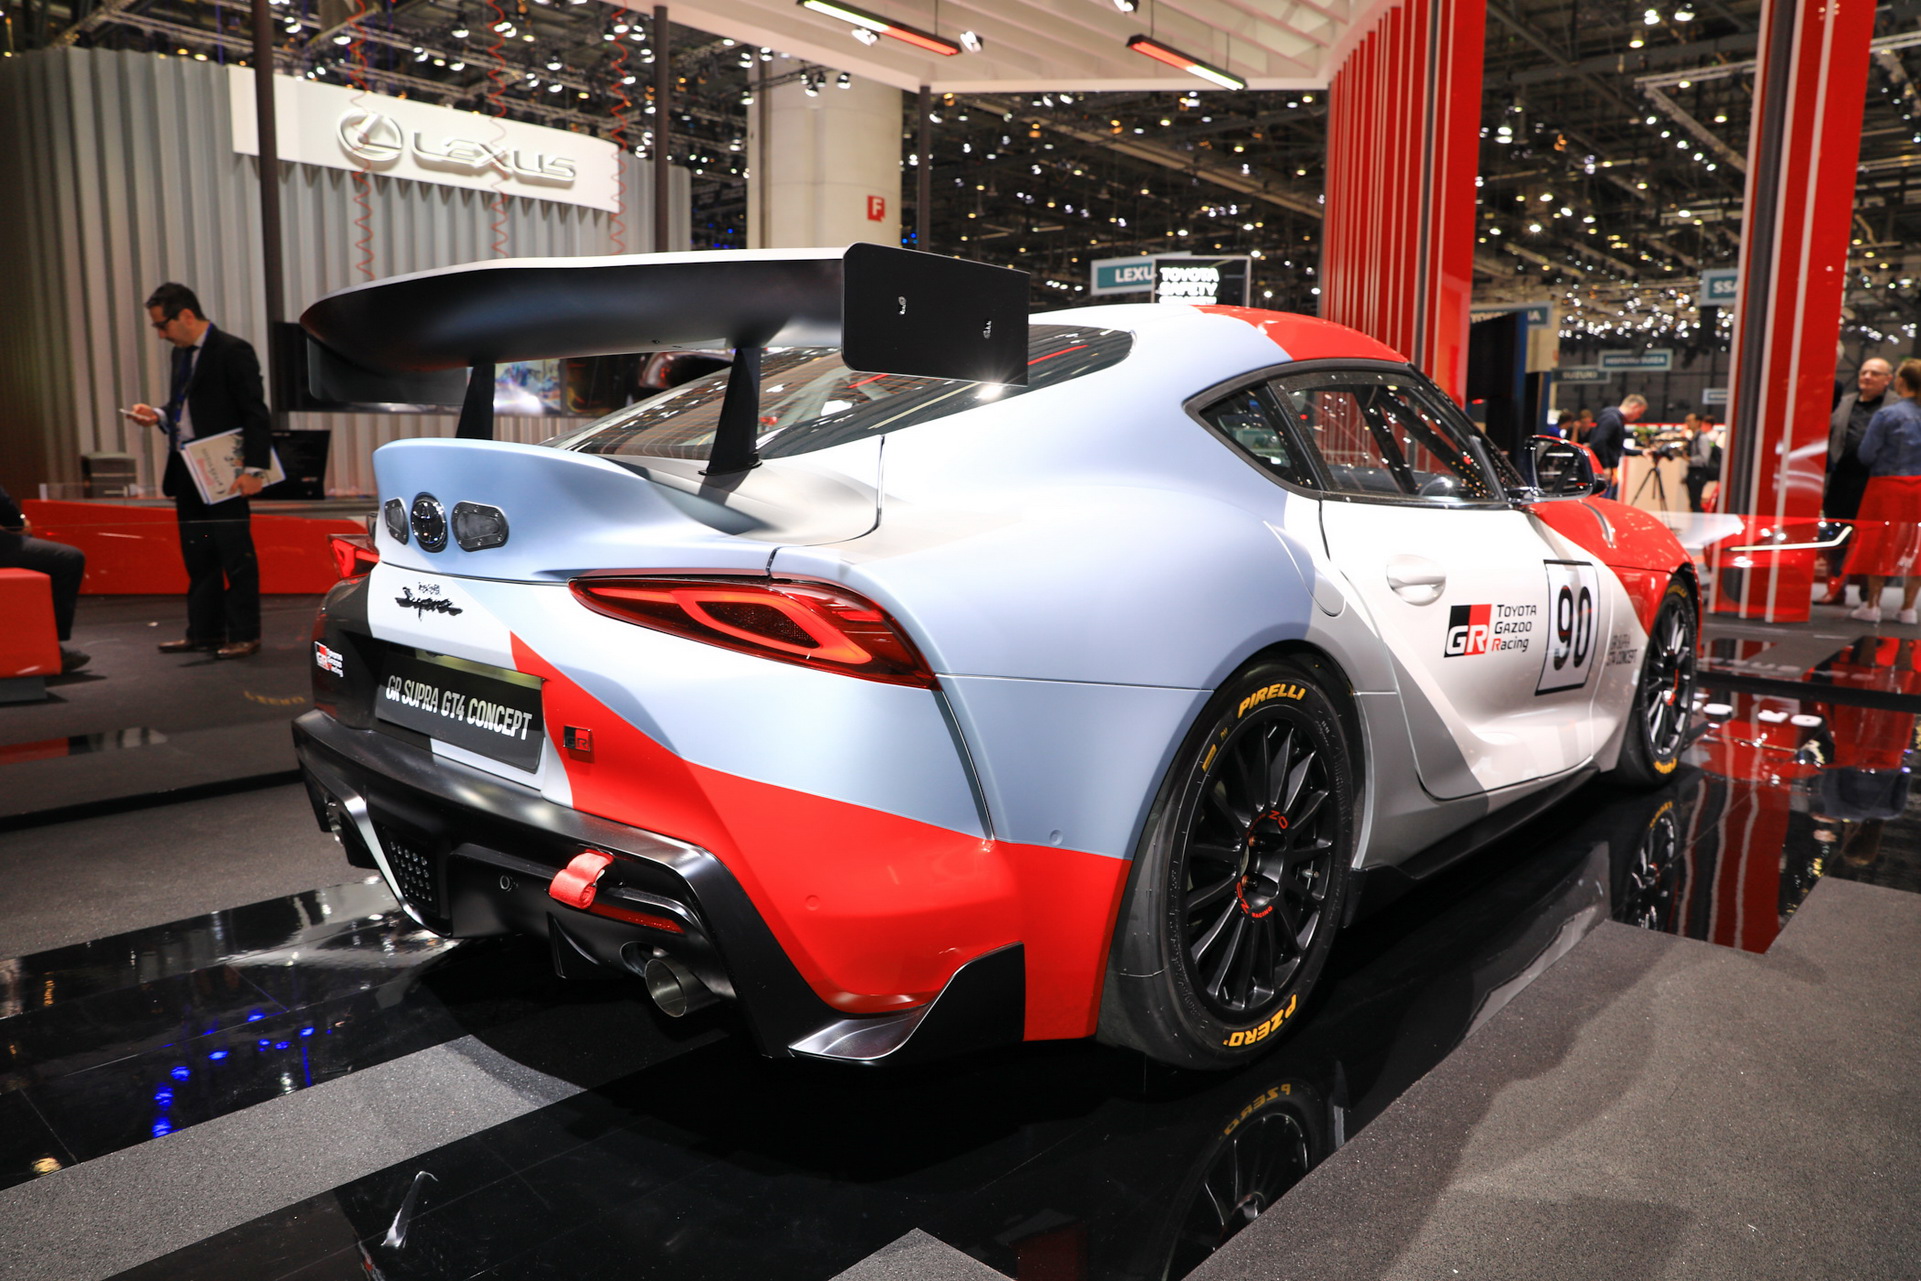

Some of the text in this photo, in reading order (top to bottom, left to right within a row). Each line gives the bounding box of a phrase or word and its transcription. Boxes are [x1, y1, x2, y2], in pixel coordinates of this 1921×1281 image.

[411, 131, 576, 184] LEXUS
[872, 198, 883, 216] F
[1160, 267, 1220, 282] TOYOTA
[1497, 604, 1537, 617] TOYOTA
[1446, 624, 1488, 655] GR
[1495, 621, 1532, 634] GAZOO
[1554, 585, 1592, 670] 90
[1491, 636, 1529, 652] Racing
[386, 675, 532, 740] GR SUPRA GT4 CONCEPT
[1238, 684, 1306, 719] PIRELLI
